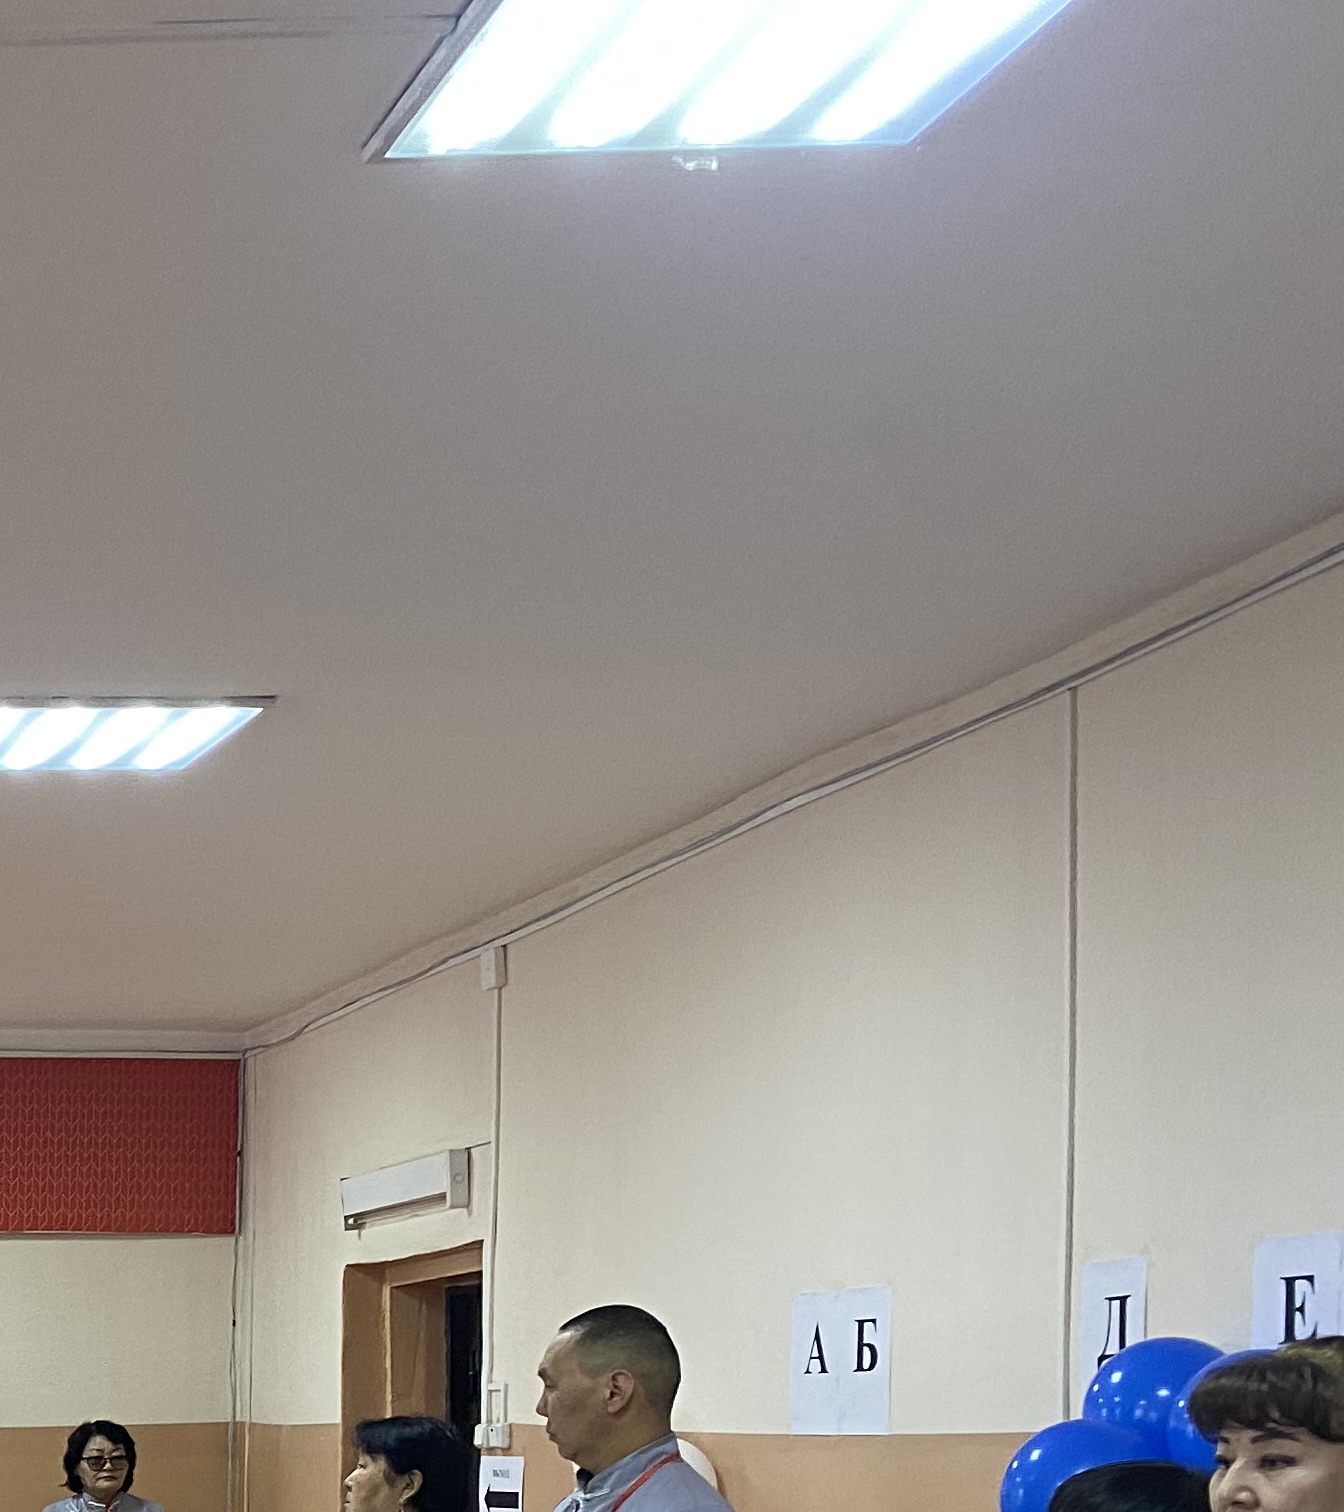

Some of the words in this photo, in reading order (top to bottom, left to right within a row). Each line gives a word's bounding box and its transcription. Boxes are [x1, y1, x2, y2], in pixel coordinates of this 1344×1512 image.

[1277, 1274, 1319, 1345] Е
[803, 1321, 829, 1375] А
[852, 1317, 878, 1373] Б
